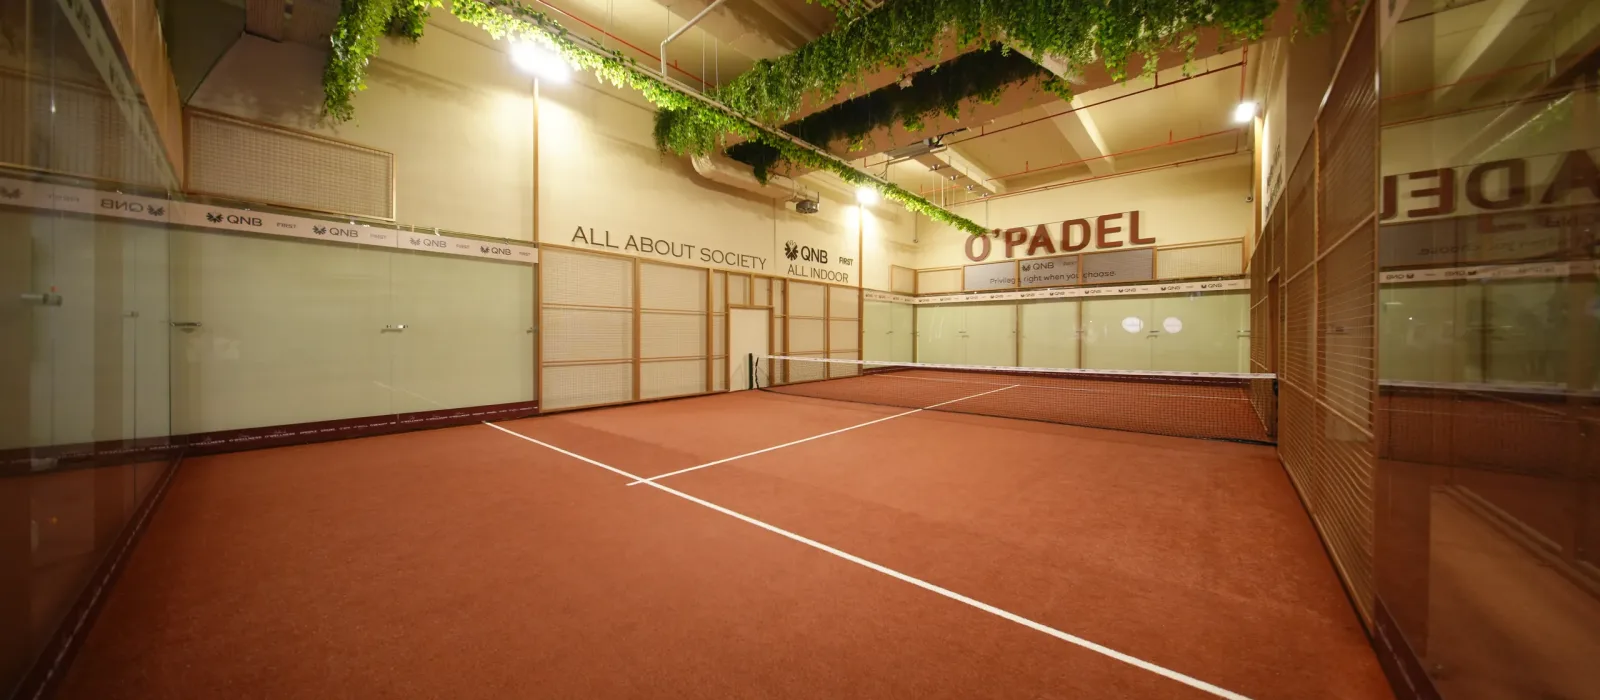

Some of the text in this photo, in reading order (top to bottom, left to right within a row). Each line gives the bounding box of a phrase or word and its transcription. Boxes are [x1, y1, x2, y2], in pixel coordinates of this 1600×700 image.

[226, 214, 262, 226] QNB
[329, 227, 358, 238] QNB
[422, 238, 447, 248] QNB
[572, 226, 766, 270] ALL ABOUT SOCIETY
[491, 247, 511, 256] QNB
[801, 246, 853, 266] QNB FIRST
[1033, 262, 1054, 270] QNB
[788, 264, 848, 283] ALL INDOOR
[1024, 274, 1042, 283] right
